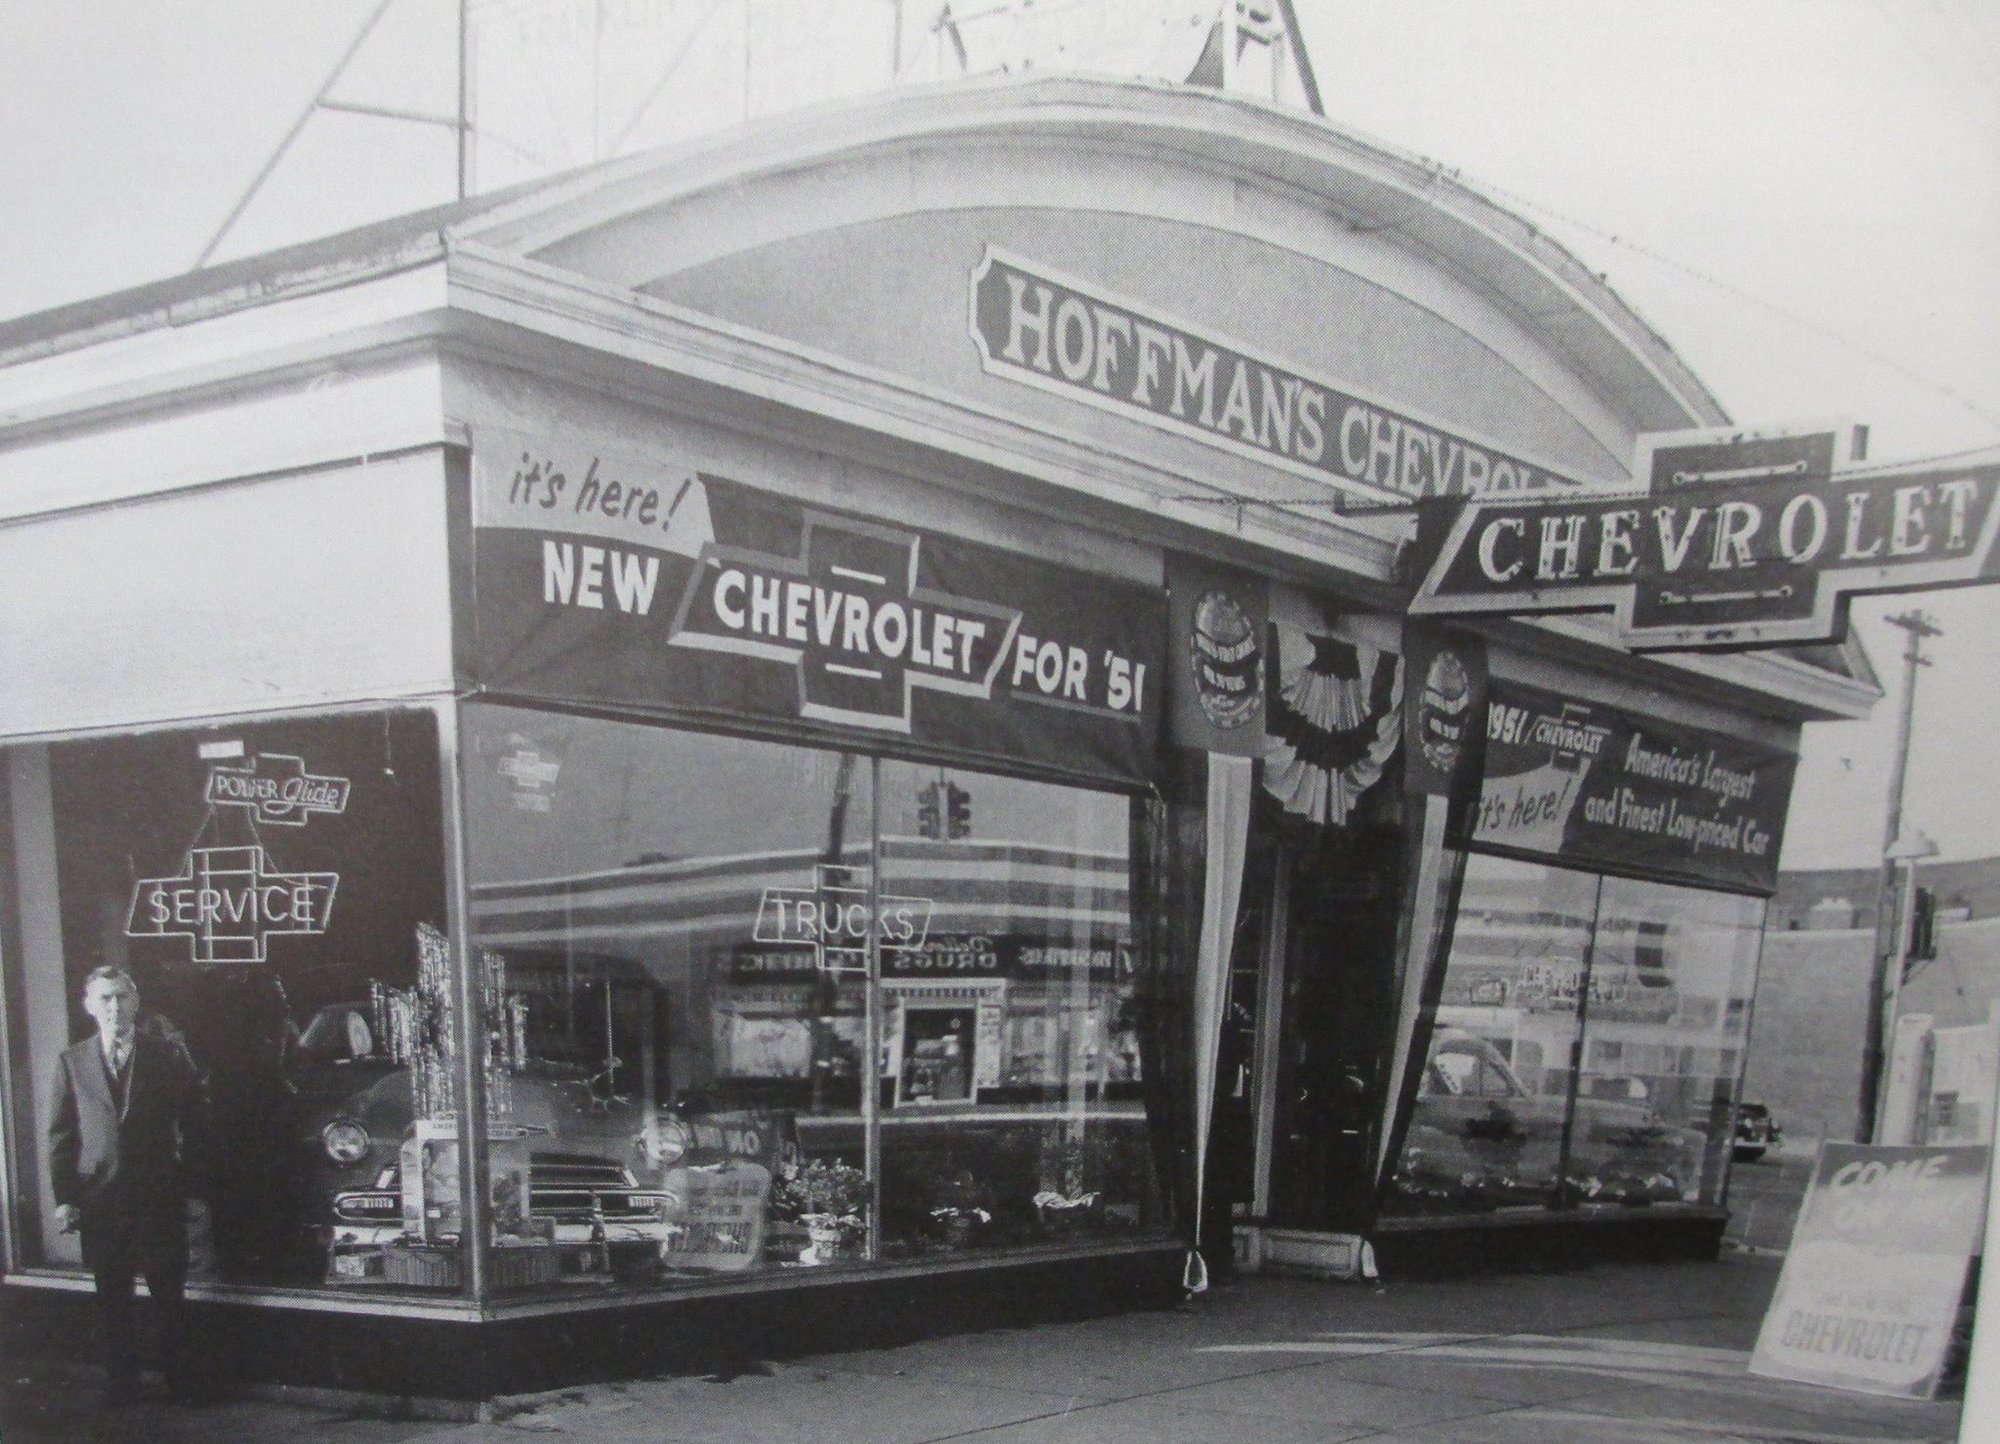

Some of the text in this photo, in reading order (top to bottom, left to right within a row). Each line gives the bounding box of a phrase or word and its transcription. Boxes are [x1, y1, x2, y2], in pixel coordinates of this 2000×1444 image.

[1003, 273, 1565, 497] HOFFMAN'S CHEVRO
[510, 452, 692, 532] it's here!
[1478, 481, 1978, 582] CHEVROLET
[543, 540, 660, 615] NEW
[714, 569, 985, 674] CHEVROLET
[1012, 634, 1088, 700] FOR
[1104, 650, 1146, 712] '51
[1487, 701, 1529, 744] 1951
[1535, 721, 1603, 754] CHEVROLET
[216, 775, 279, 799] POWER
[1625, 732, 1756, 807] America's Largest
[1508, 777, 1572, 828] here!
[1585, 787, 1617, 827] and
[1620, 787, 1665, 834] Finest
[1743, 817, 1770, 855] Car
[151, 885, 316, 924] SERVICE
[767, 900, 914, 940] TRUCKS
[1831, 1155, 1949, 1191] COME
[1780, 1309, 1929, 1364] CHEVROLET
